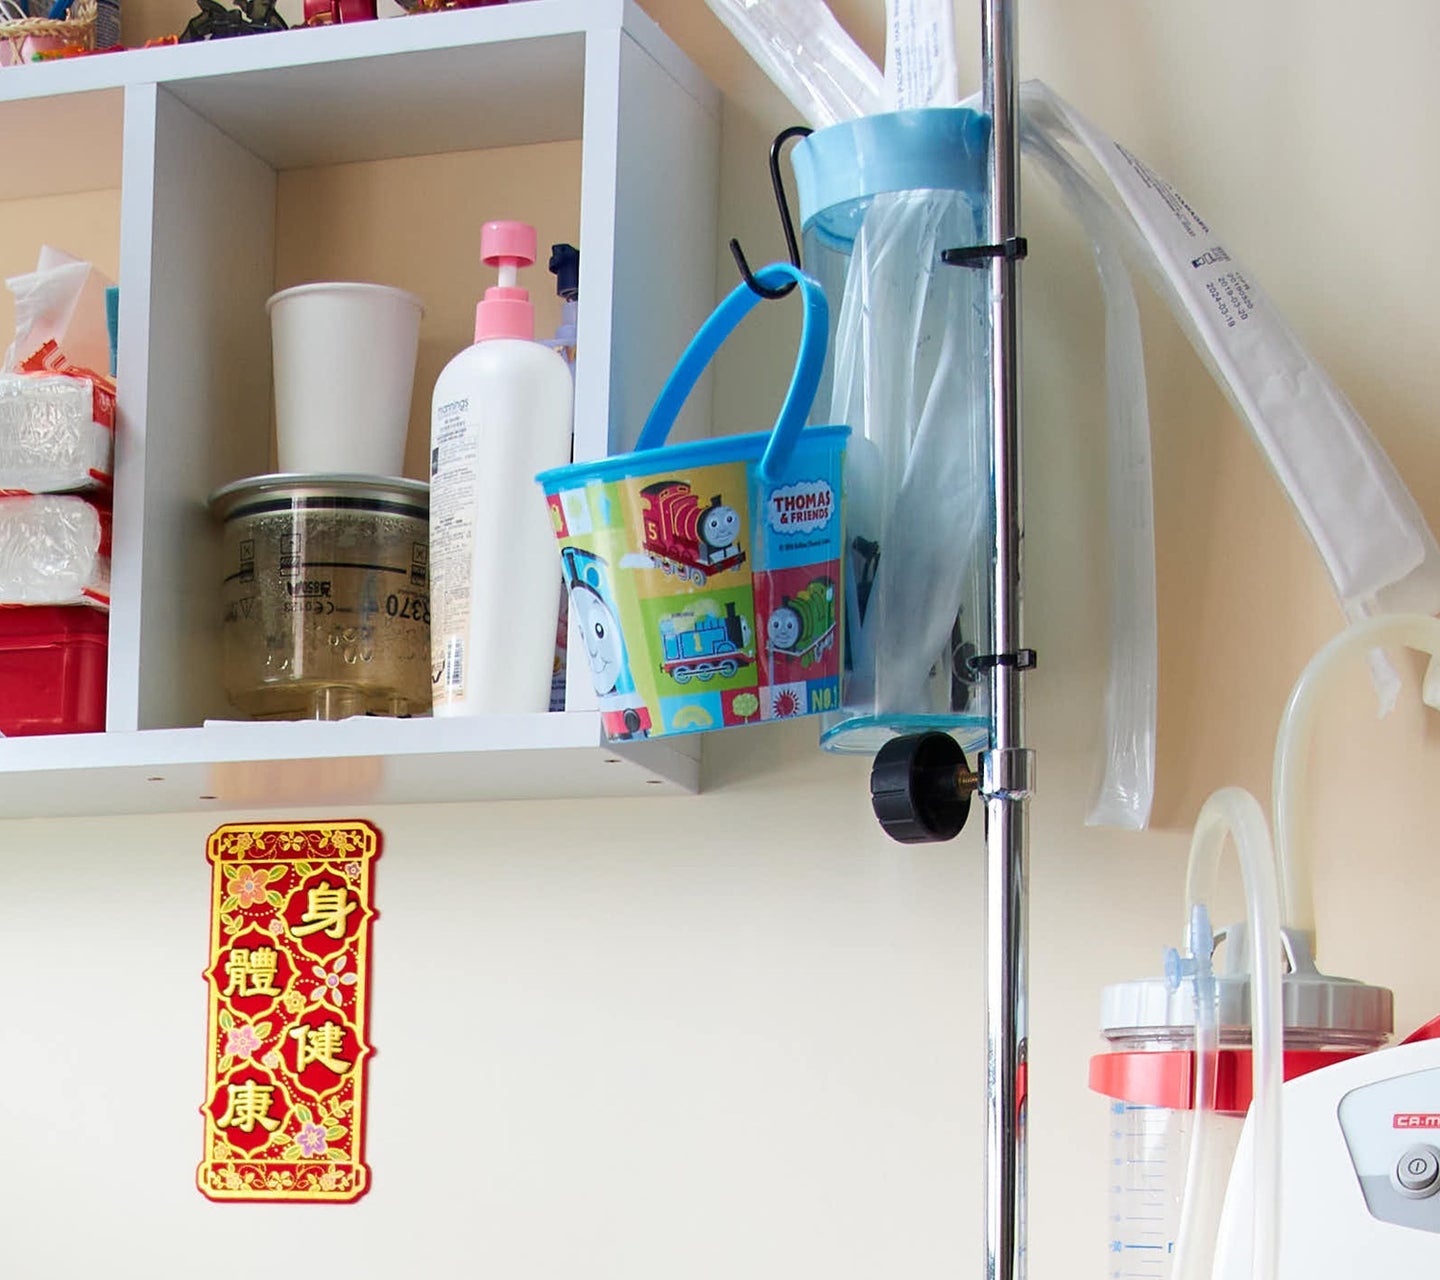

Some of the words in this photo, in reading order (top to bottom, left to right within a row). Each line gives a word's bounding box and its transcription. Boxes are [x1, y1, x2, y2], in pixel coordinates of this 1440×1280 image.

[1206, 282, 1236, 328] 2024-03-19
[773, 489, 832, 512] THOMAS
[780, 511, 789, 525] &
[790, 508, 830, 523] FRIENDS
[648, 522, 658, 541] 5
[693, 632, 703, 653] 1
[216, 880, 358, 1134] 身體健康
